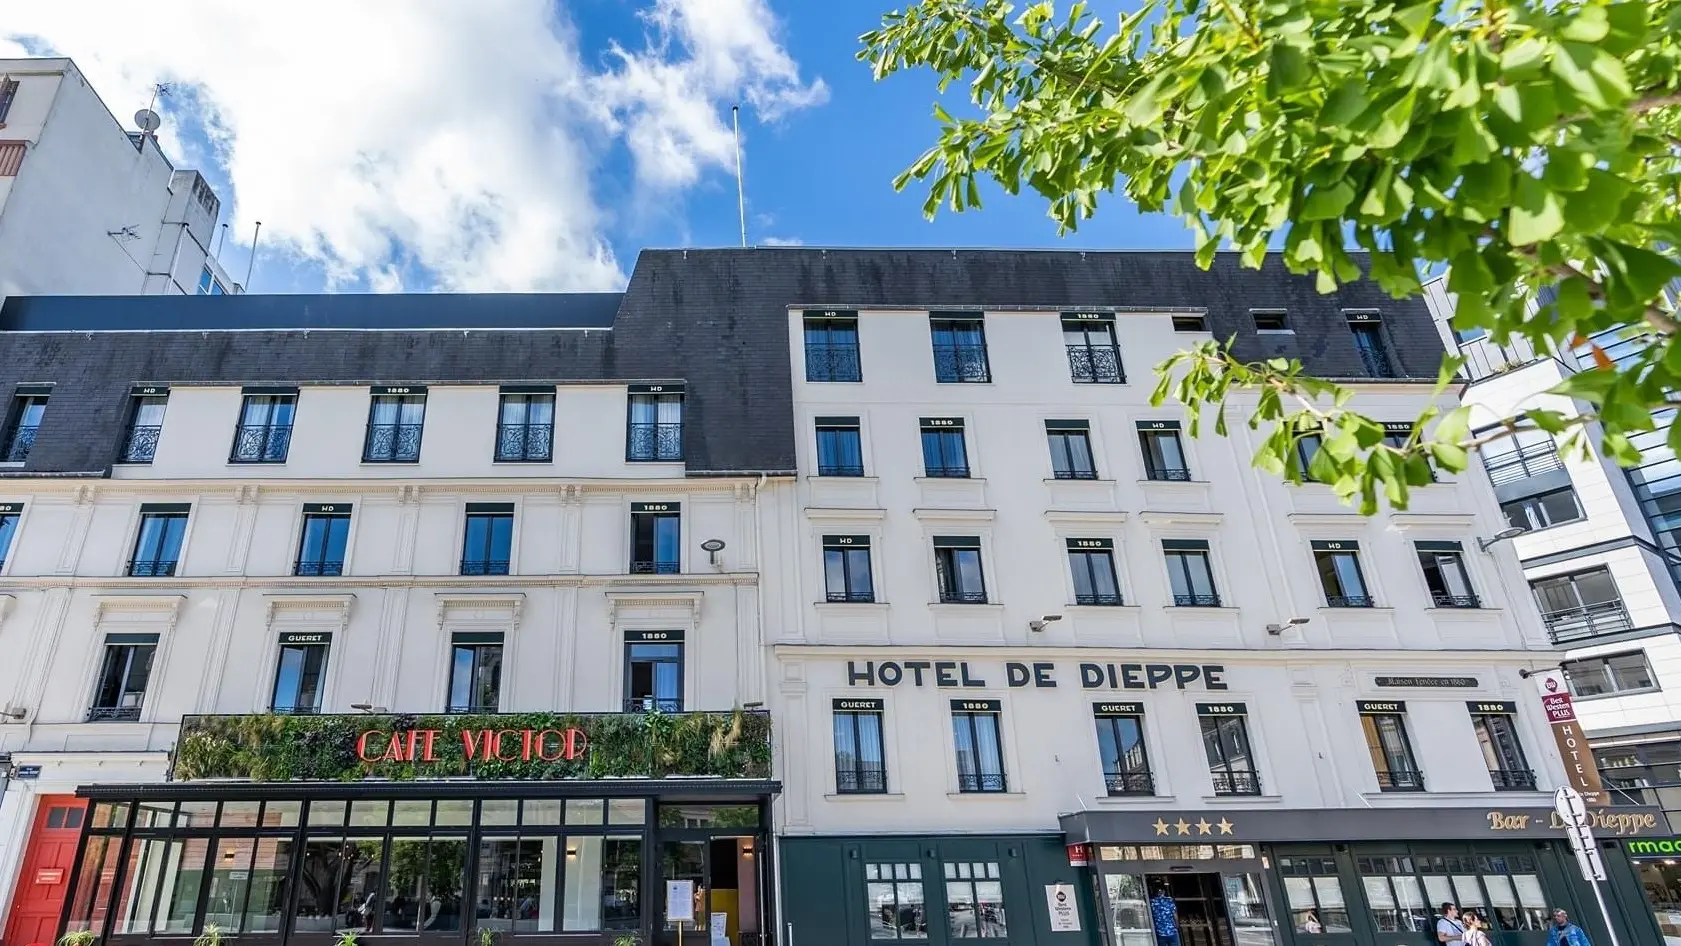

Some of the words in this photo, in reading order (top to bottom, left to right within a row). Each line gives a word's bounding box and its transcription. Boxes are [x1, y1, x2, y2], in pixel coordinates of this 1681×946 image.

[848, 661, 986, 687] HOTEL
[1006, 662, 1057, 687] DE
[1080, 663, 1228, 689] DIEPPE
[356, 729, 443, 762] CAFE
[462, 728, 588, 762] VICTOR
[1562, 725, 1589, 787] HOTEL
[1487, 811, 1530, 830] Bar
